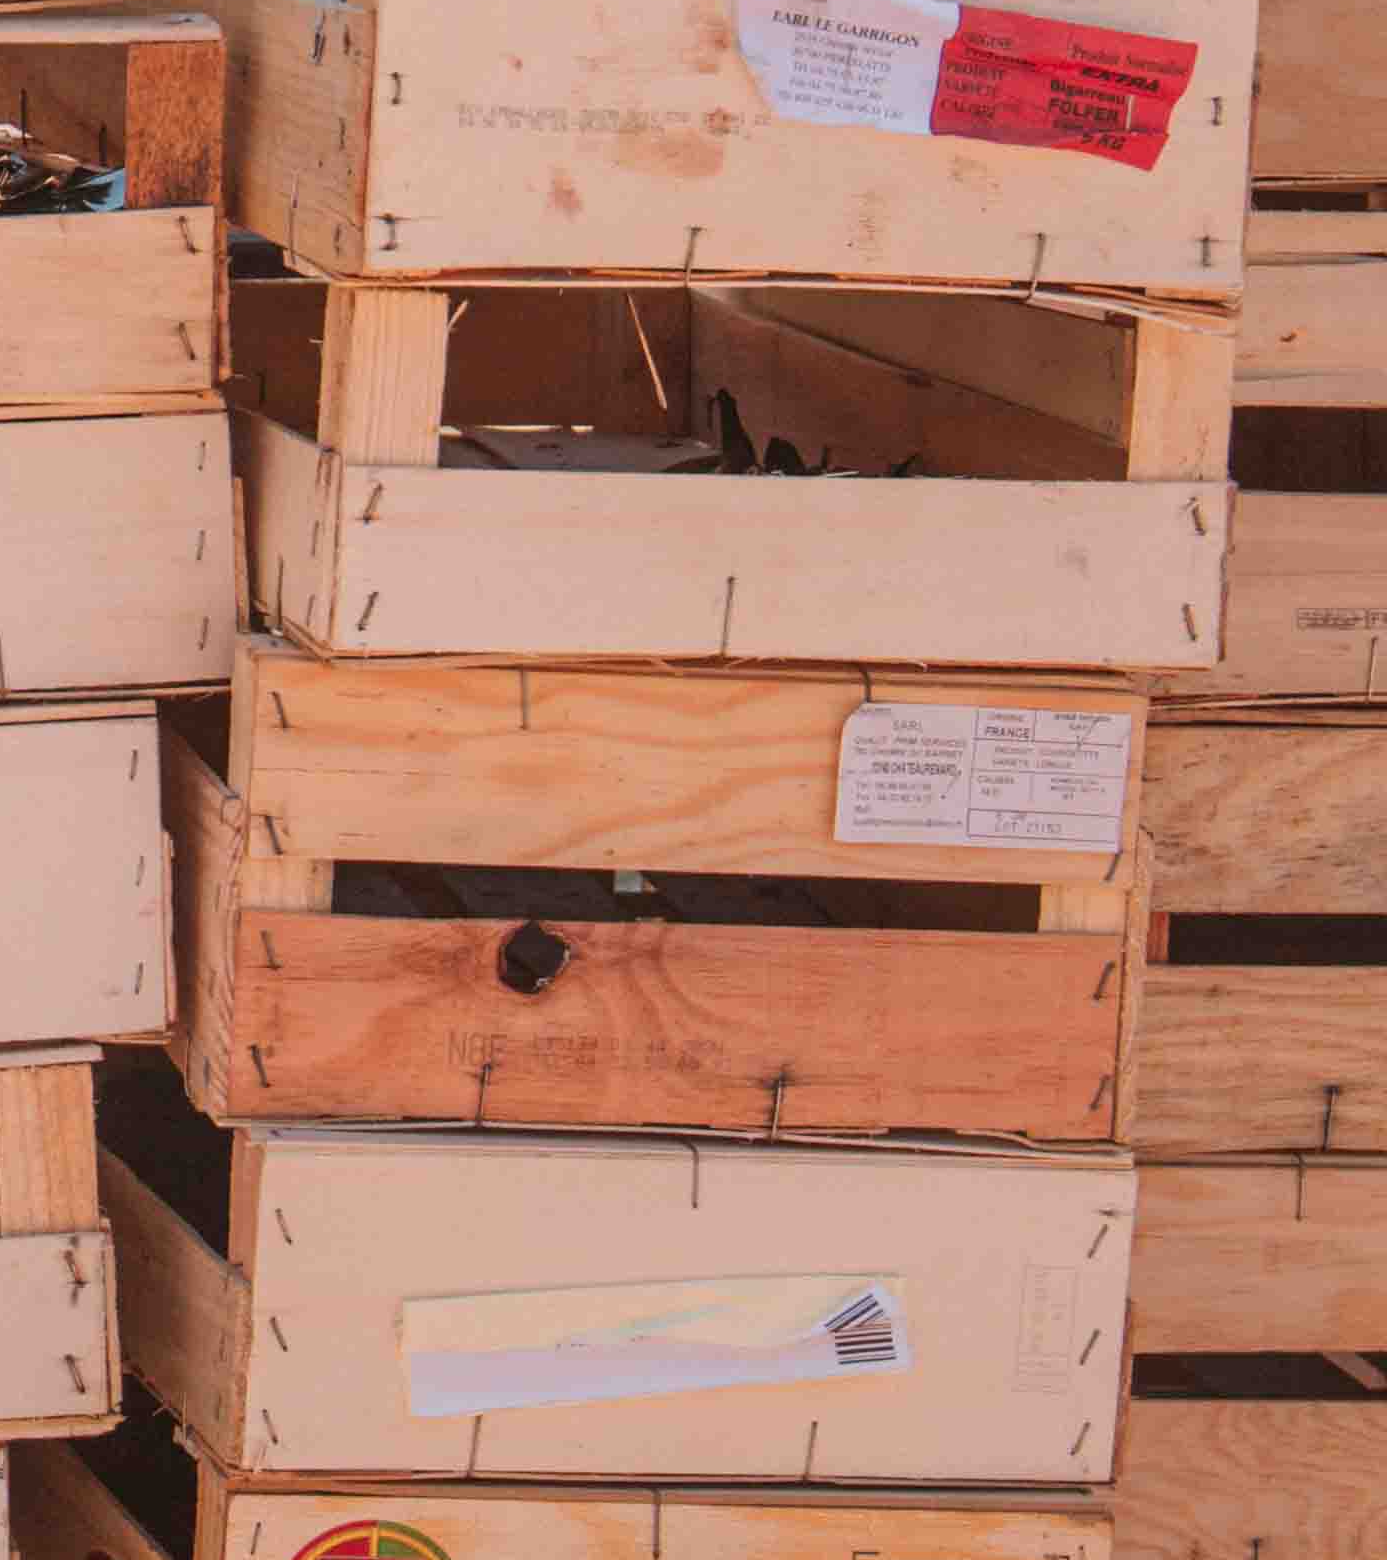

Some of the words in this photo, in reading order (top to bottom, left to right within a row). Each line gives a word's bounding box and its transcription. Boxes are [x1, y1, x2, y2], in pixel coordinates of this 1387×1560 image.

[836, 21, 920, 49] GARRIGON
[1050, 79, 1126, 104] Bigarreau
[984, 726, 1031, 740] FRANCE
